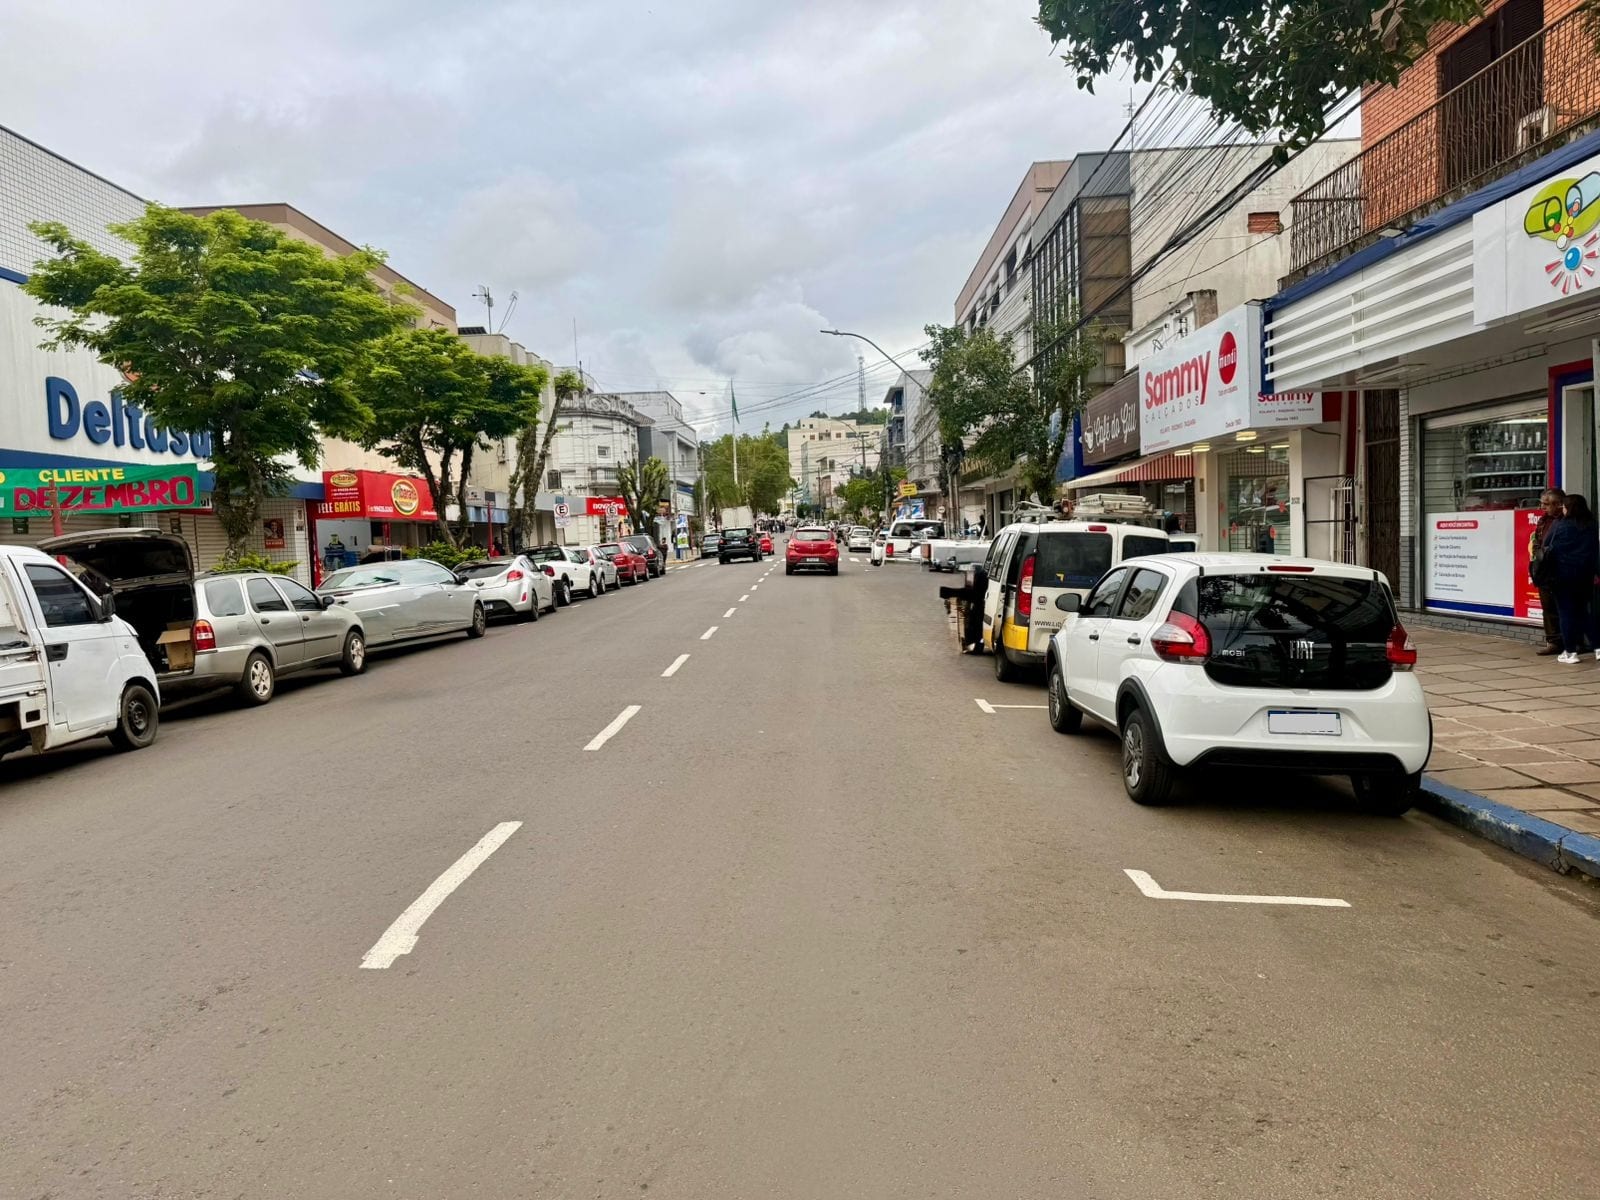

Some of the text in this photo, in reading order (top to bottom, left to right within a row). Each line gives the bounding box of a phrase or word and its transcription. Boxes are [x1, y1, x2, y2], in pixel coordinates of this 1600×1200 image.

[1145, 350, 1211, 410] Sammy
[46, 376, 214, 458] Deltasu
[39, 467, 125, 483] CLIENTE
[13, 475, 196, 512] DEZEMBRO
[317, 502, 333, 514] TELE
[334, 499, 361, 513] GRÁTIS
[1289, 640, 1315, 660] FIAT
